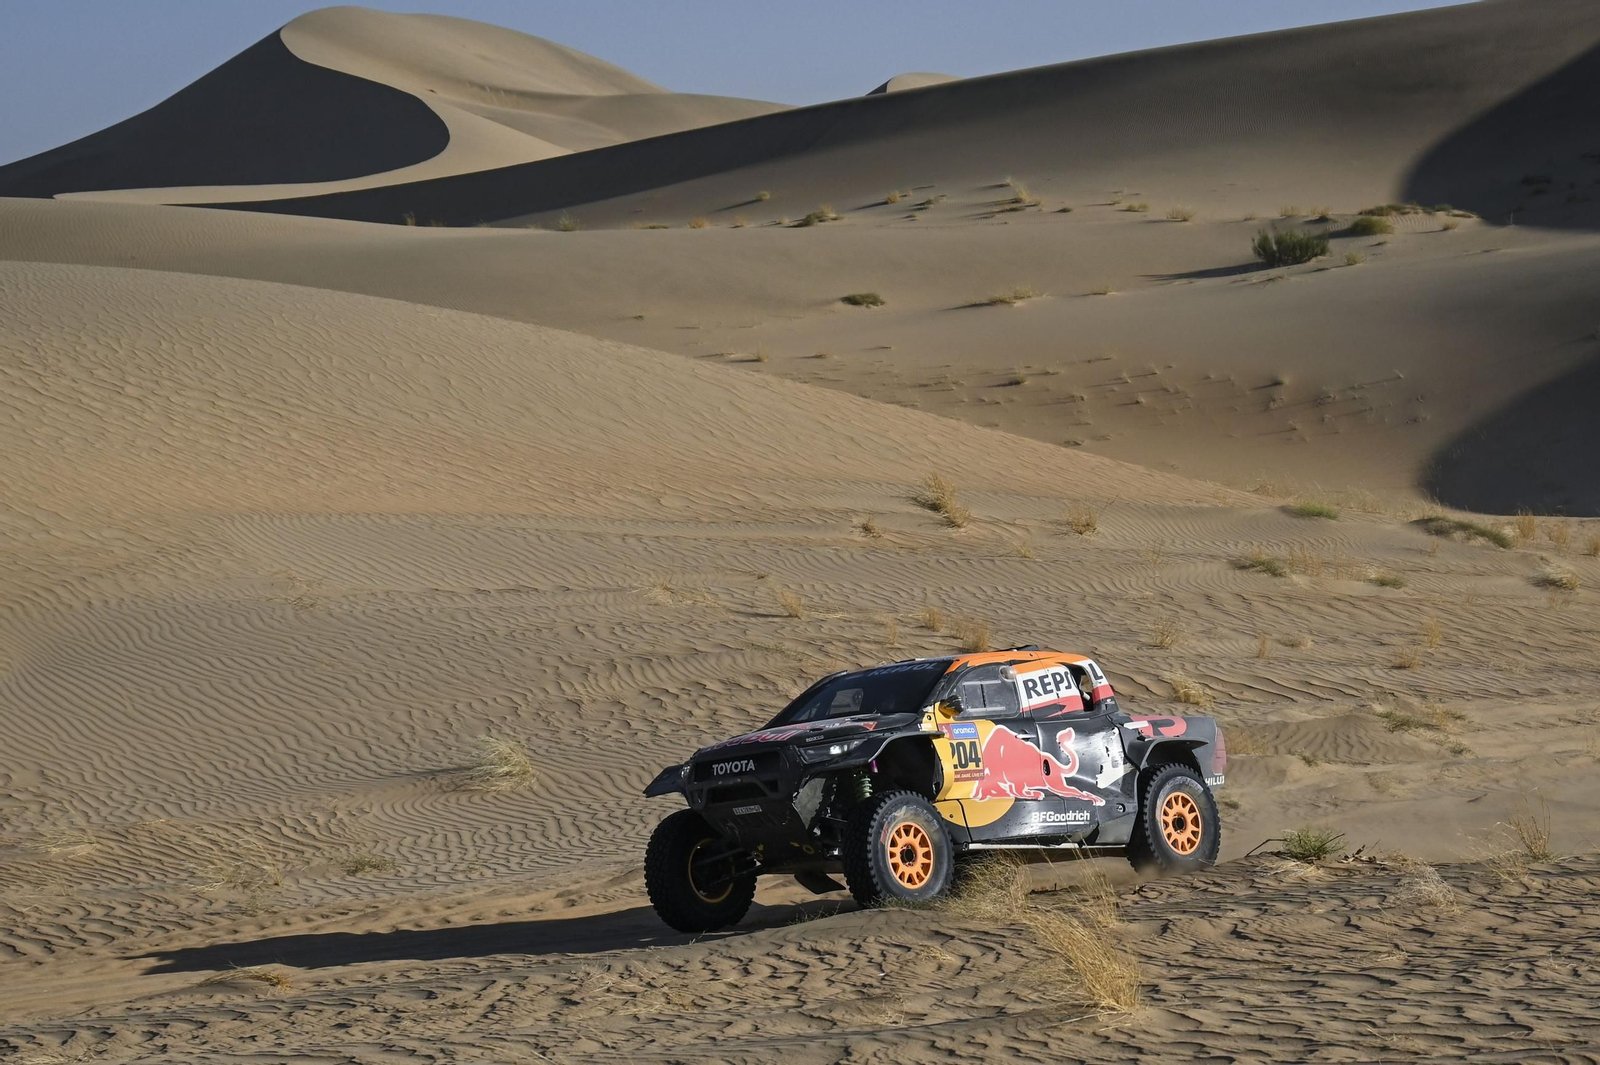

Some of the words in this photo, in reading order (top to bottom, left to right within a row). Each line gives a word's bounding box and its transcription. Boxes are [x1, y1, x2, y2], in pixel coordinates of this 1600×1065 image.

[868, 662, 938, 677] REPSOL
[1022, 663, 1104, 699] REPSL
[741, 728, 804, 745] Bull
[953, 727, 976, 735] aramco
[712, 759, 756, 776] TOYOTA
[1031, 810, 1091, 822] BFGoodrich
